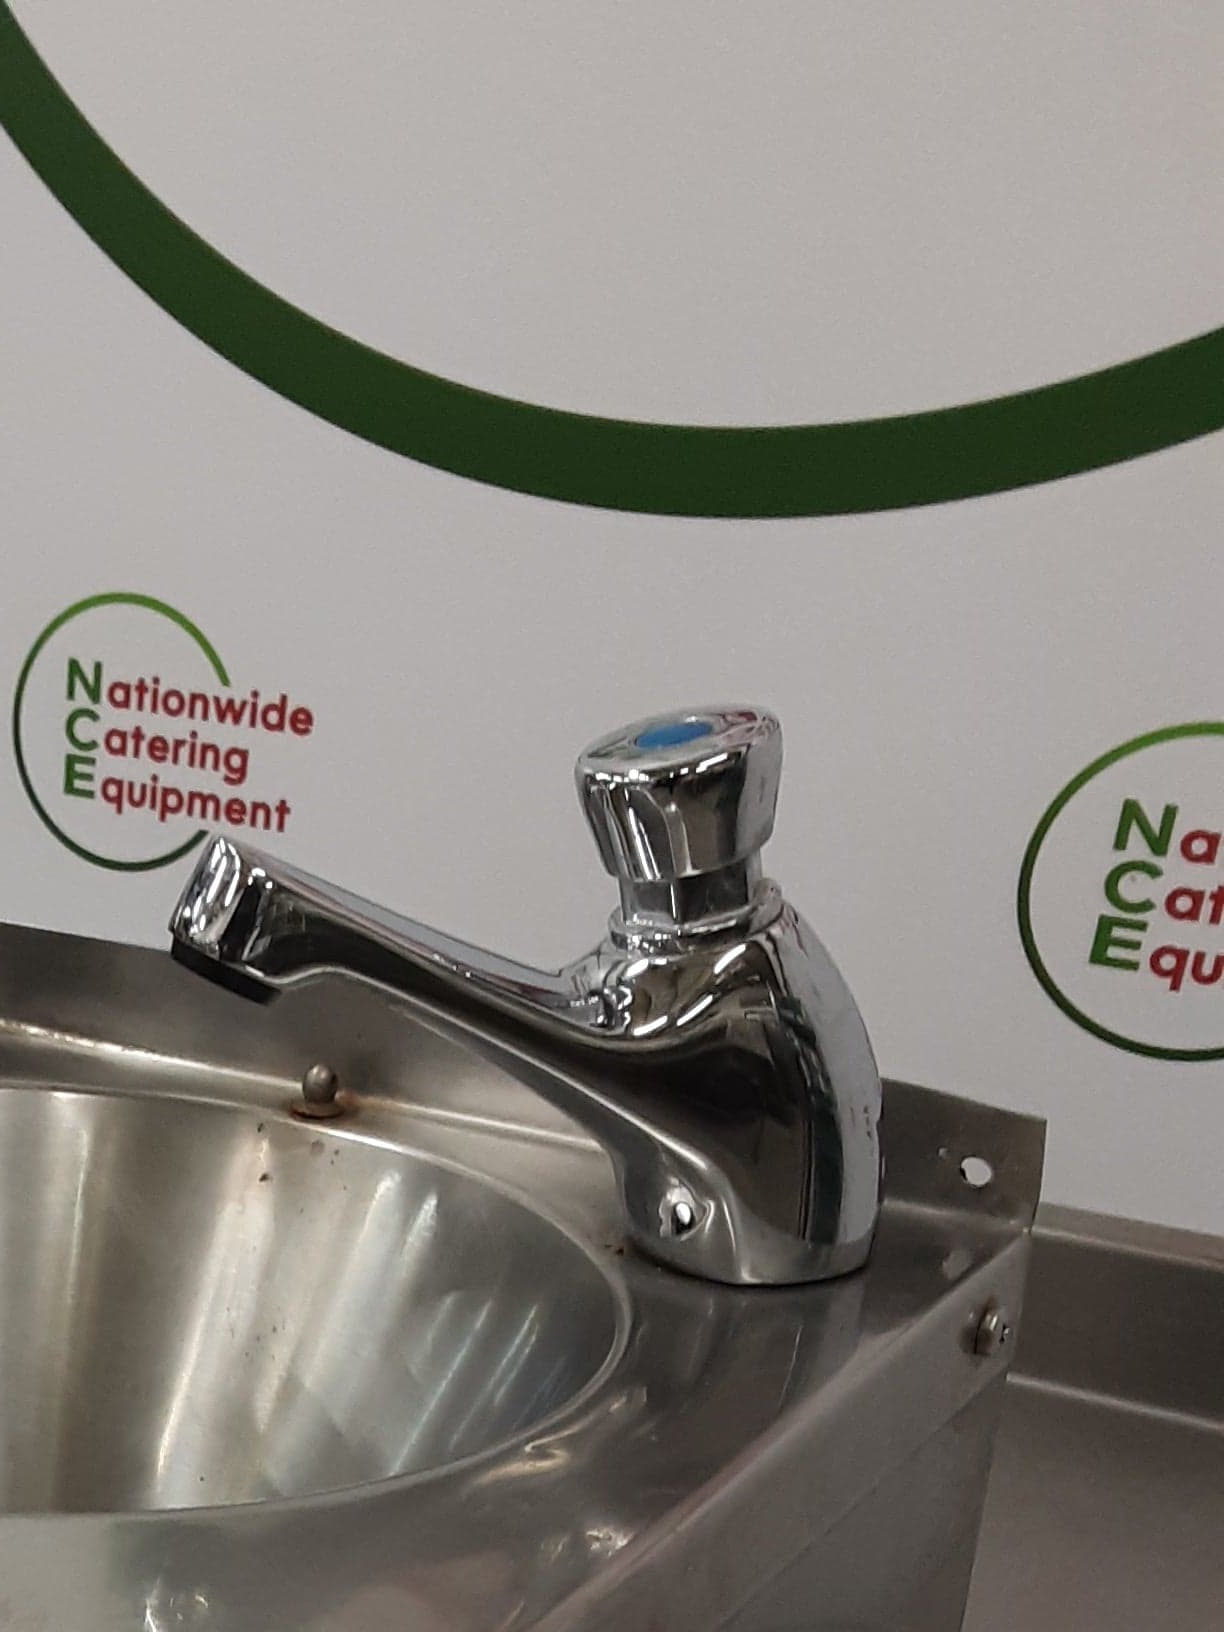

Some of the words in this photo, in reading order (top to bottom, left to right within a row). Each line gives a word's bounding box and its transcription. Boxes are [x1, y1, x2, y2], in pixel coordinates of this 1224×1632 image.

[66, 656, 314, 736] Nationwide
[64, 708, 249, 786] Catering
[62, 753, 291, 833] Equipment
